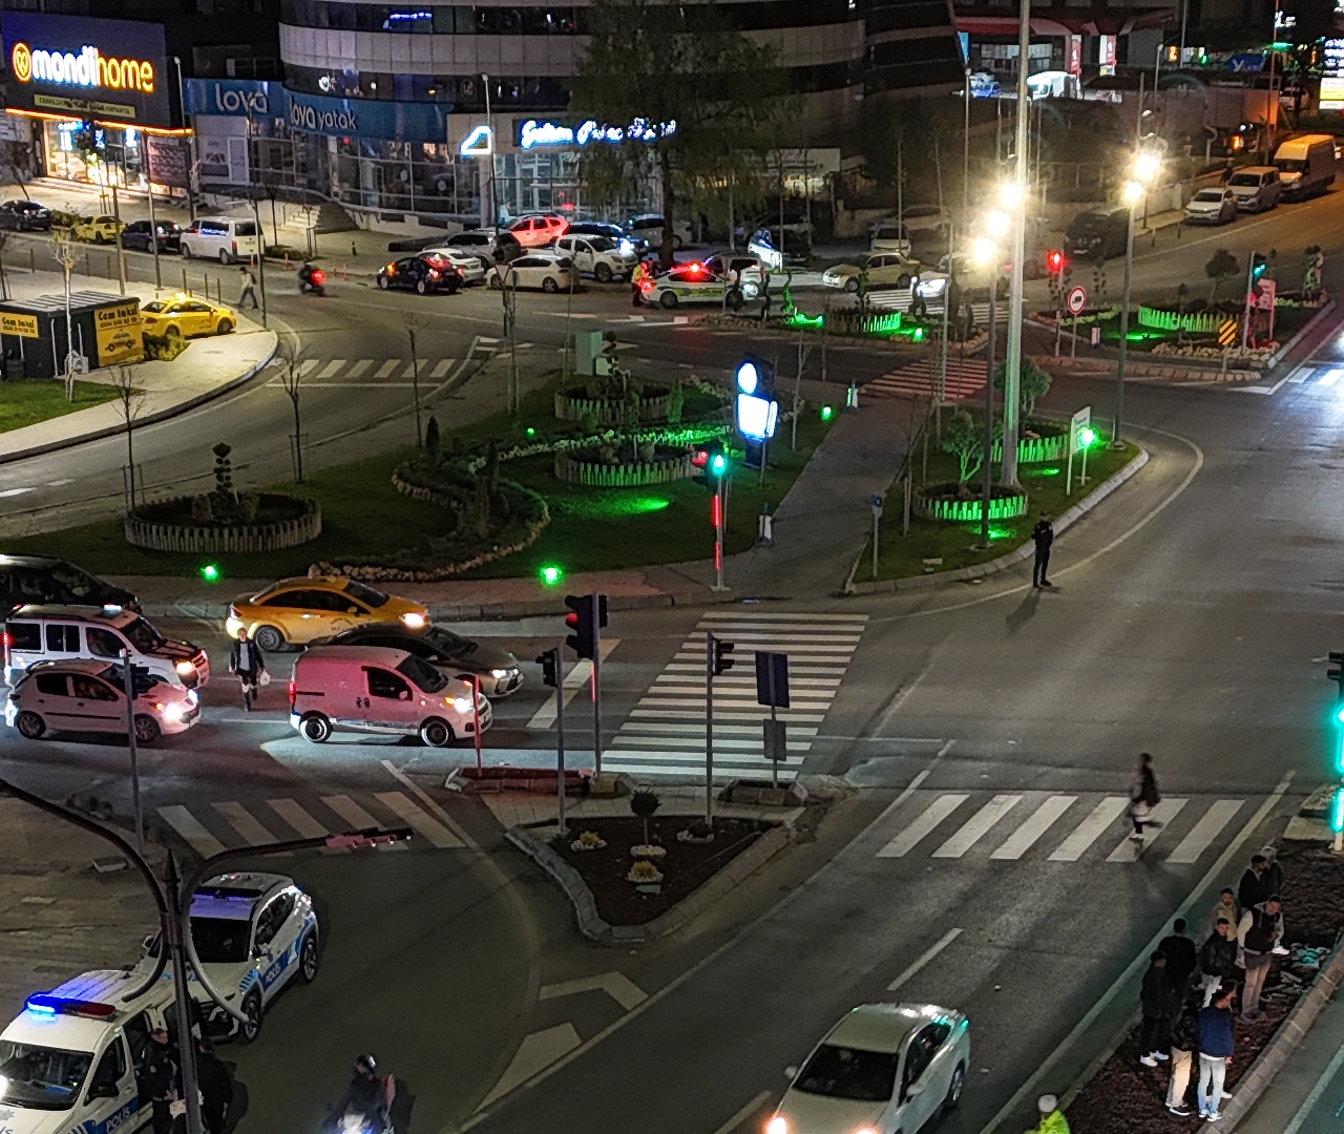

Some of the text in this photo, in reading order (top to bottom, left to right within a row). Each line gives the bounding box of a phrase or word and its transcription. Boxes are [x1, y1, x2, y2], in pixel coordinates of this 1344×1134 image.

[32, 45, 153, 93] mondihome
[215, 83, 268, 113] lova
[290, 97, 357, 130] lova yatak
[106, 1106, 131, 1132] POLİS
